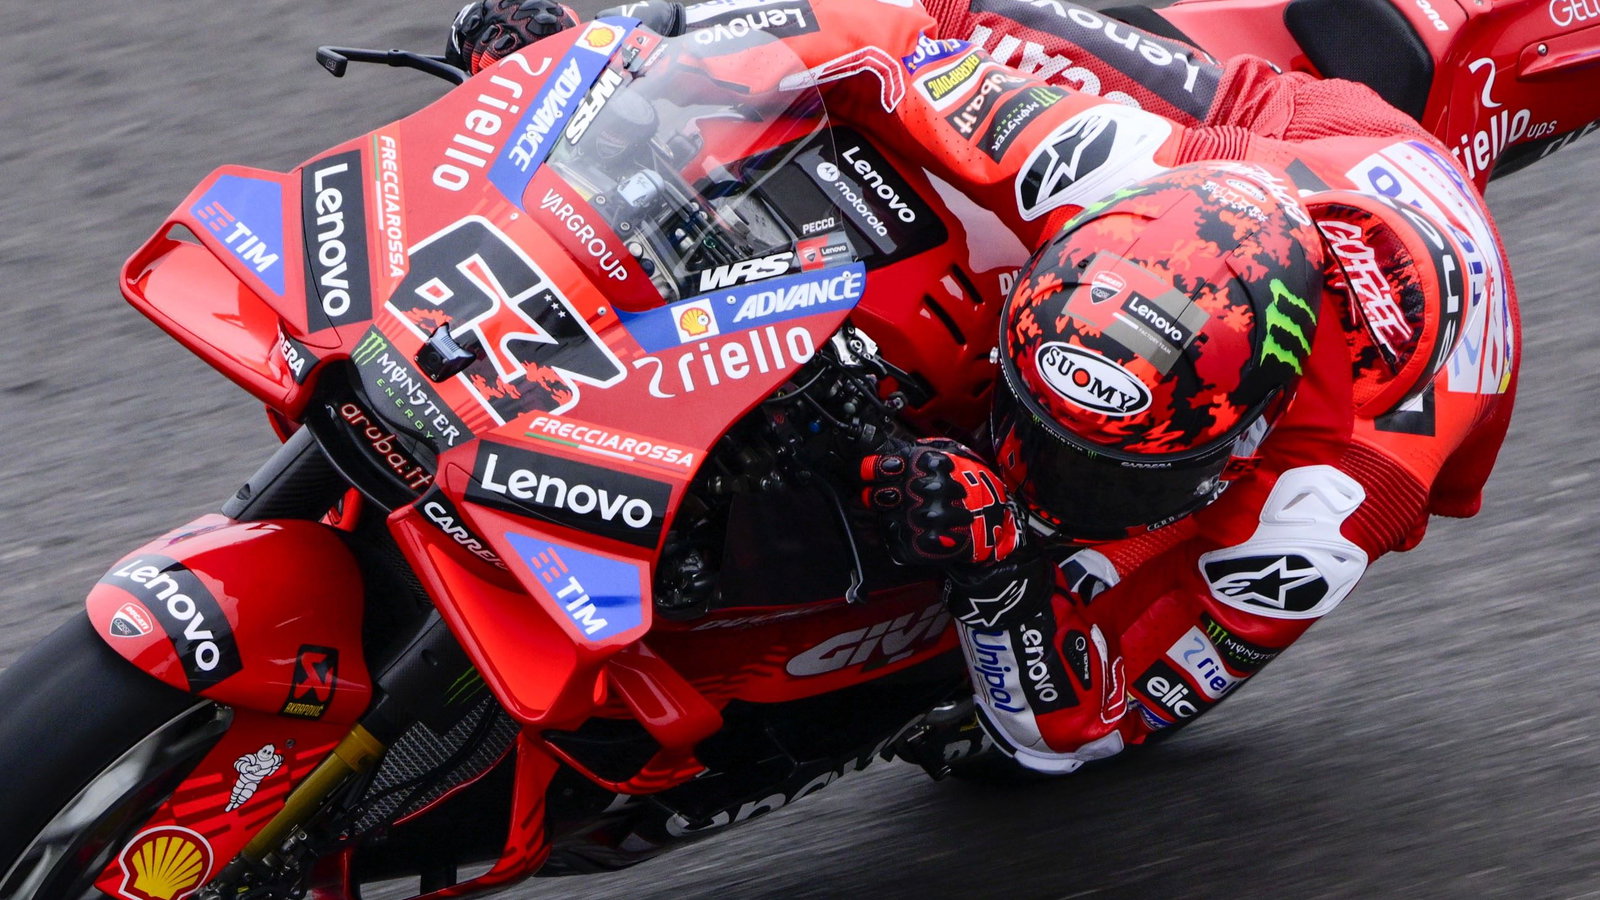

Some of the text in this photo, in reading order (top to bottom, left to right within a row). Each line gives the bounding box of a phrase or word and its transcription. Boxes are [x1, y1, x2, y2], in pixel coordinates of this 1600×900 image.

[694, 8, 807, 45] Lenovo
[1028, 0, 1201, 93] Lenov
[432, 74, 525, 192] riello
[508, 57, 583, 173] ADVANCE
[565, 68, 623, 145] WRS
[992, 101, 1040, 152] MONSTER
[379, 134, 406, 279] FRECCIAROSSA
[834, 181, 888, 238] motorola
[842, 145, 916, 224] Lenovo
[223, 220, 280, 274] TIM
[314, 163, 352, 318] Lenovo
[802, 217, 835, 235] PECCO
[822, 245, 847, 255] Lenovo
[699, 251, 794, 293] WRS
[732, 272, 862, 323] ADVANCE
[1128, 296, 1183, 341] Lenovo
[1138, 328, 1172, 355] FACTORY TEAM
[677, 326, 815, 393] riello
[1045, 346, 1137, 413] SUOMY
[376, 378, 435, 439] ENERGY
[377, 352, 460, 447] MONSTER
[340, 402, 434, 490] aruba.it
[529, 416, 694, 468] FRECCIAROSSA
[481, 453, 653, 529] Lenovo
[112, 558, 220, 672] Lenovo
[124, 605, 149, 631] DUCATI
[555, 575, 609, 636] TIM
[971, 628, 1026, 714] Unipol
